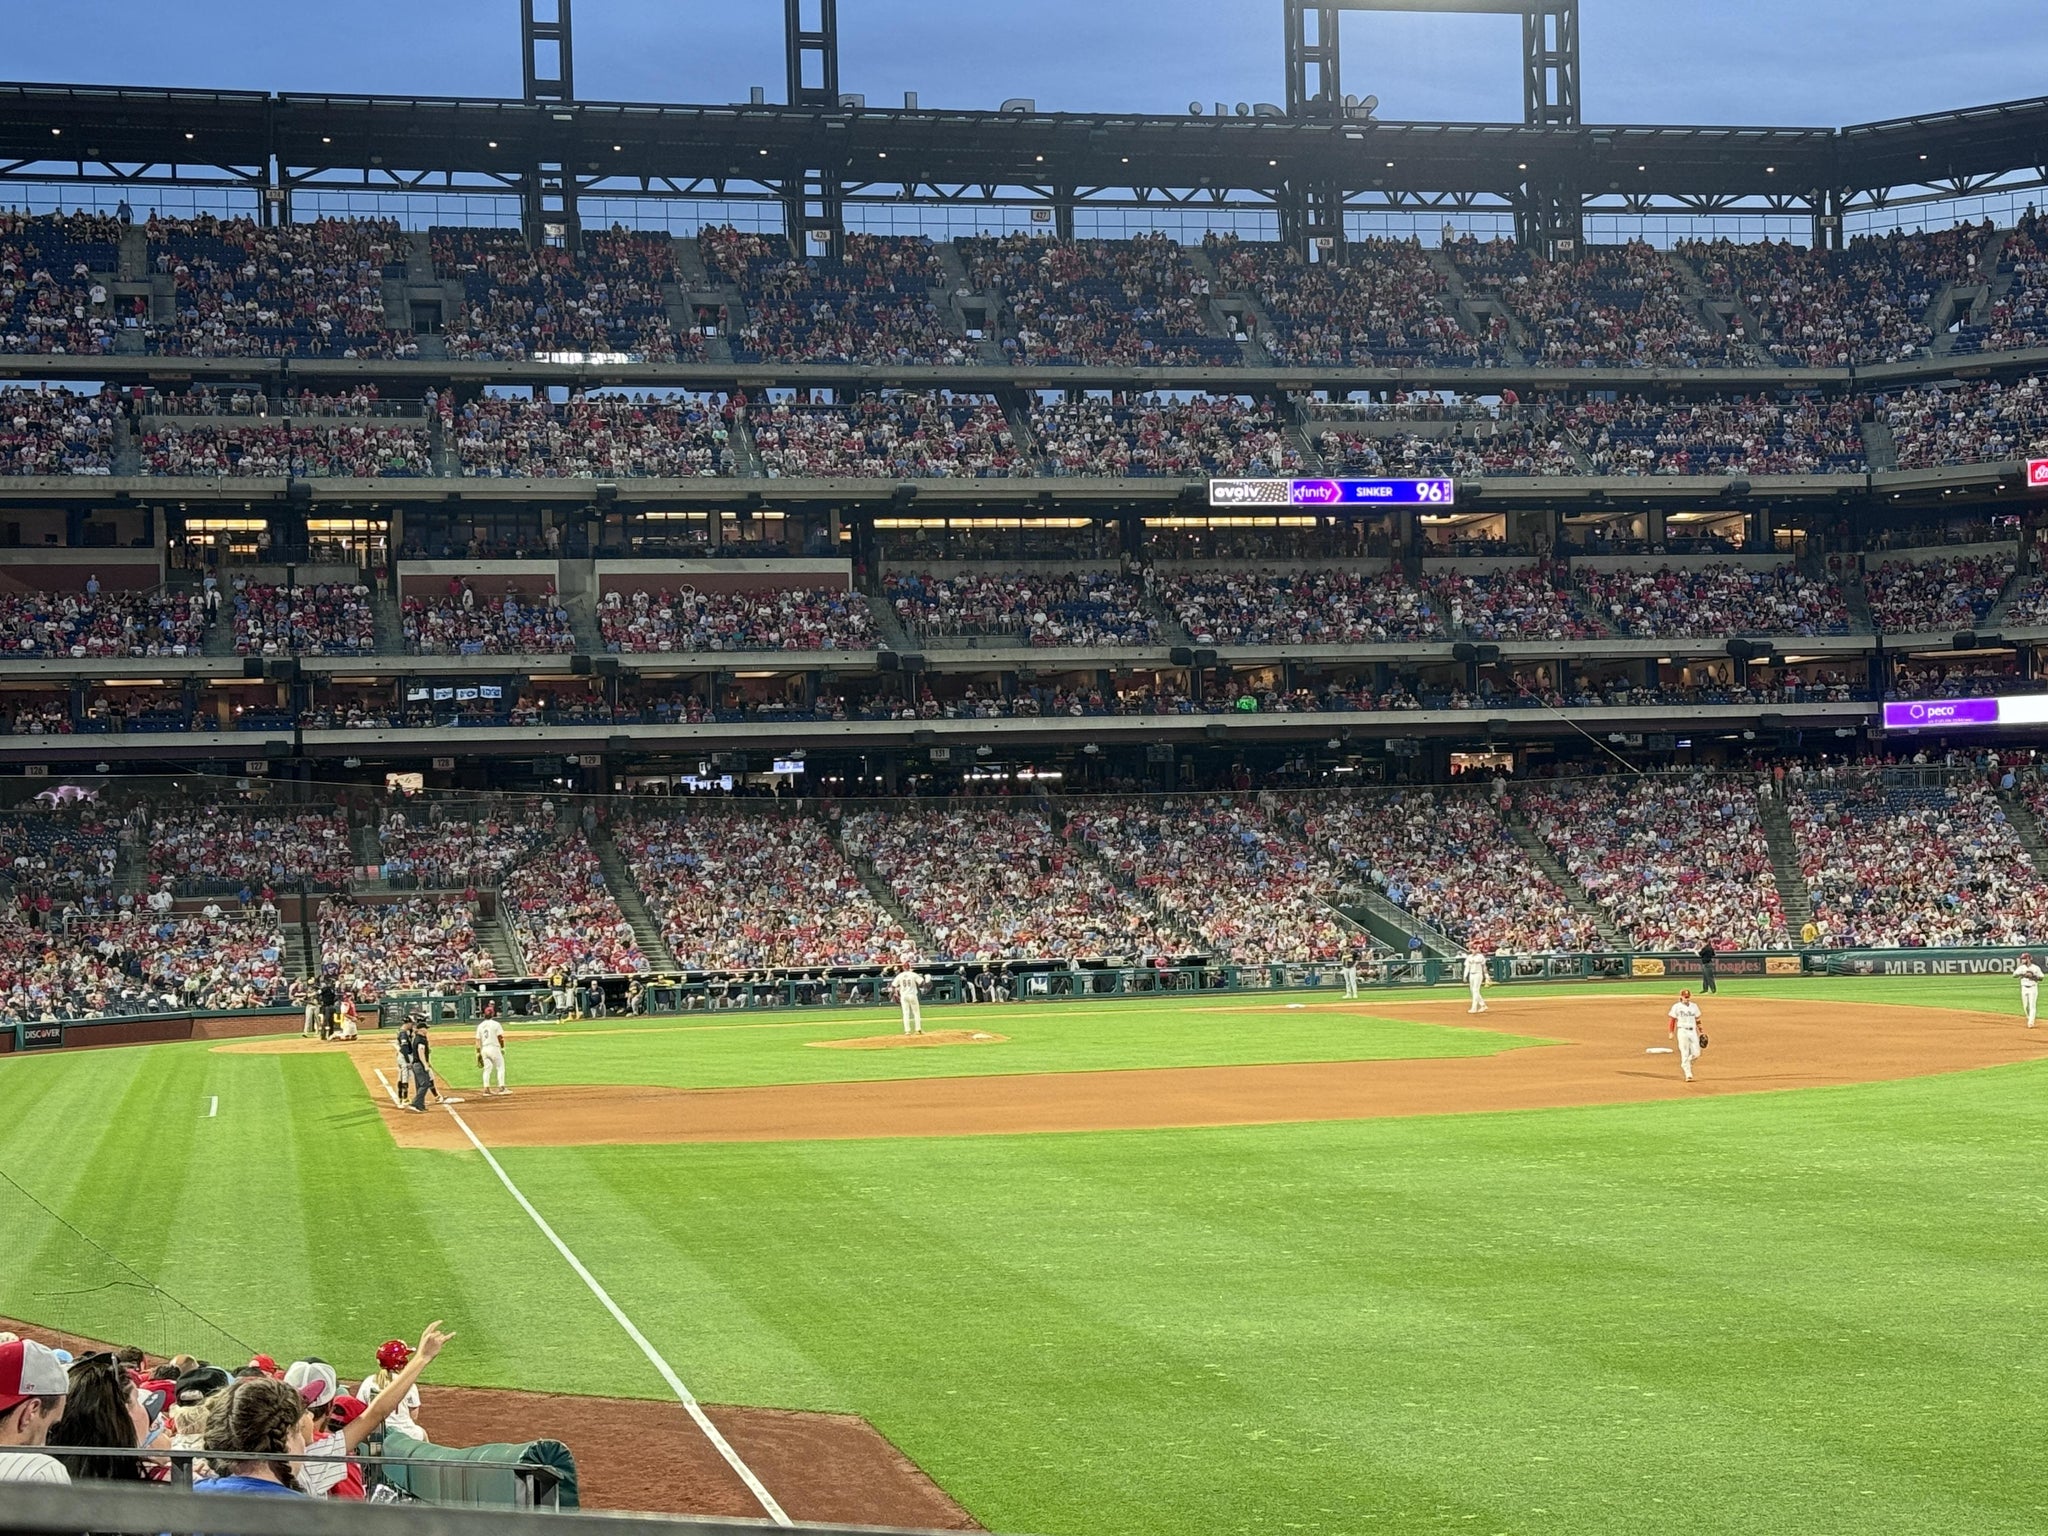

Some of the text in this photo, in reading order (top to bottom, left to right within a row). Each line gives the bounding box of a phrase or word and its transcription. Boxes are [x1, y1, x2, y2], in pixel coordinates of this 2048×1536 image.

[1036, 211, 1047, 219] 427
[1293, 485, 1332, 501] xfinity
[1356, 487, 1393, 497] SINKER
[1416, 482, 1442, 501] 96
[1928, 706, 1954, 718] peco
[30, 766, 43, 776] 126
[251, 762, 263, 771] 127
[1885, 960, 1926, 975] MLB
[1932, 957, 2020, 974] NETWOR
